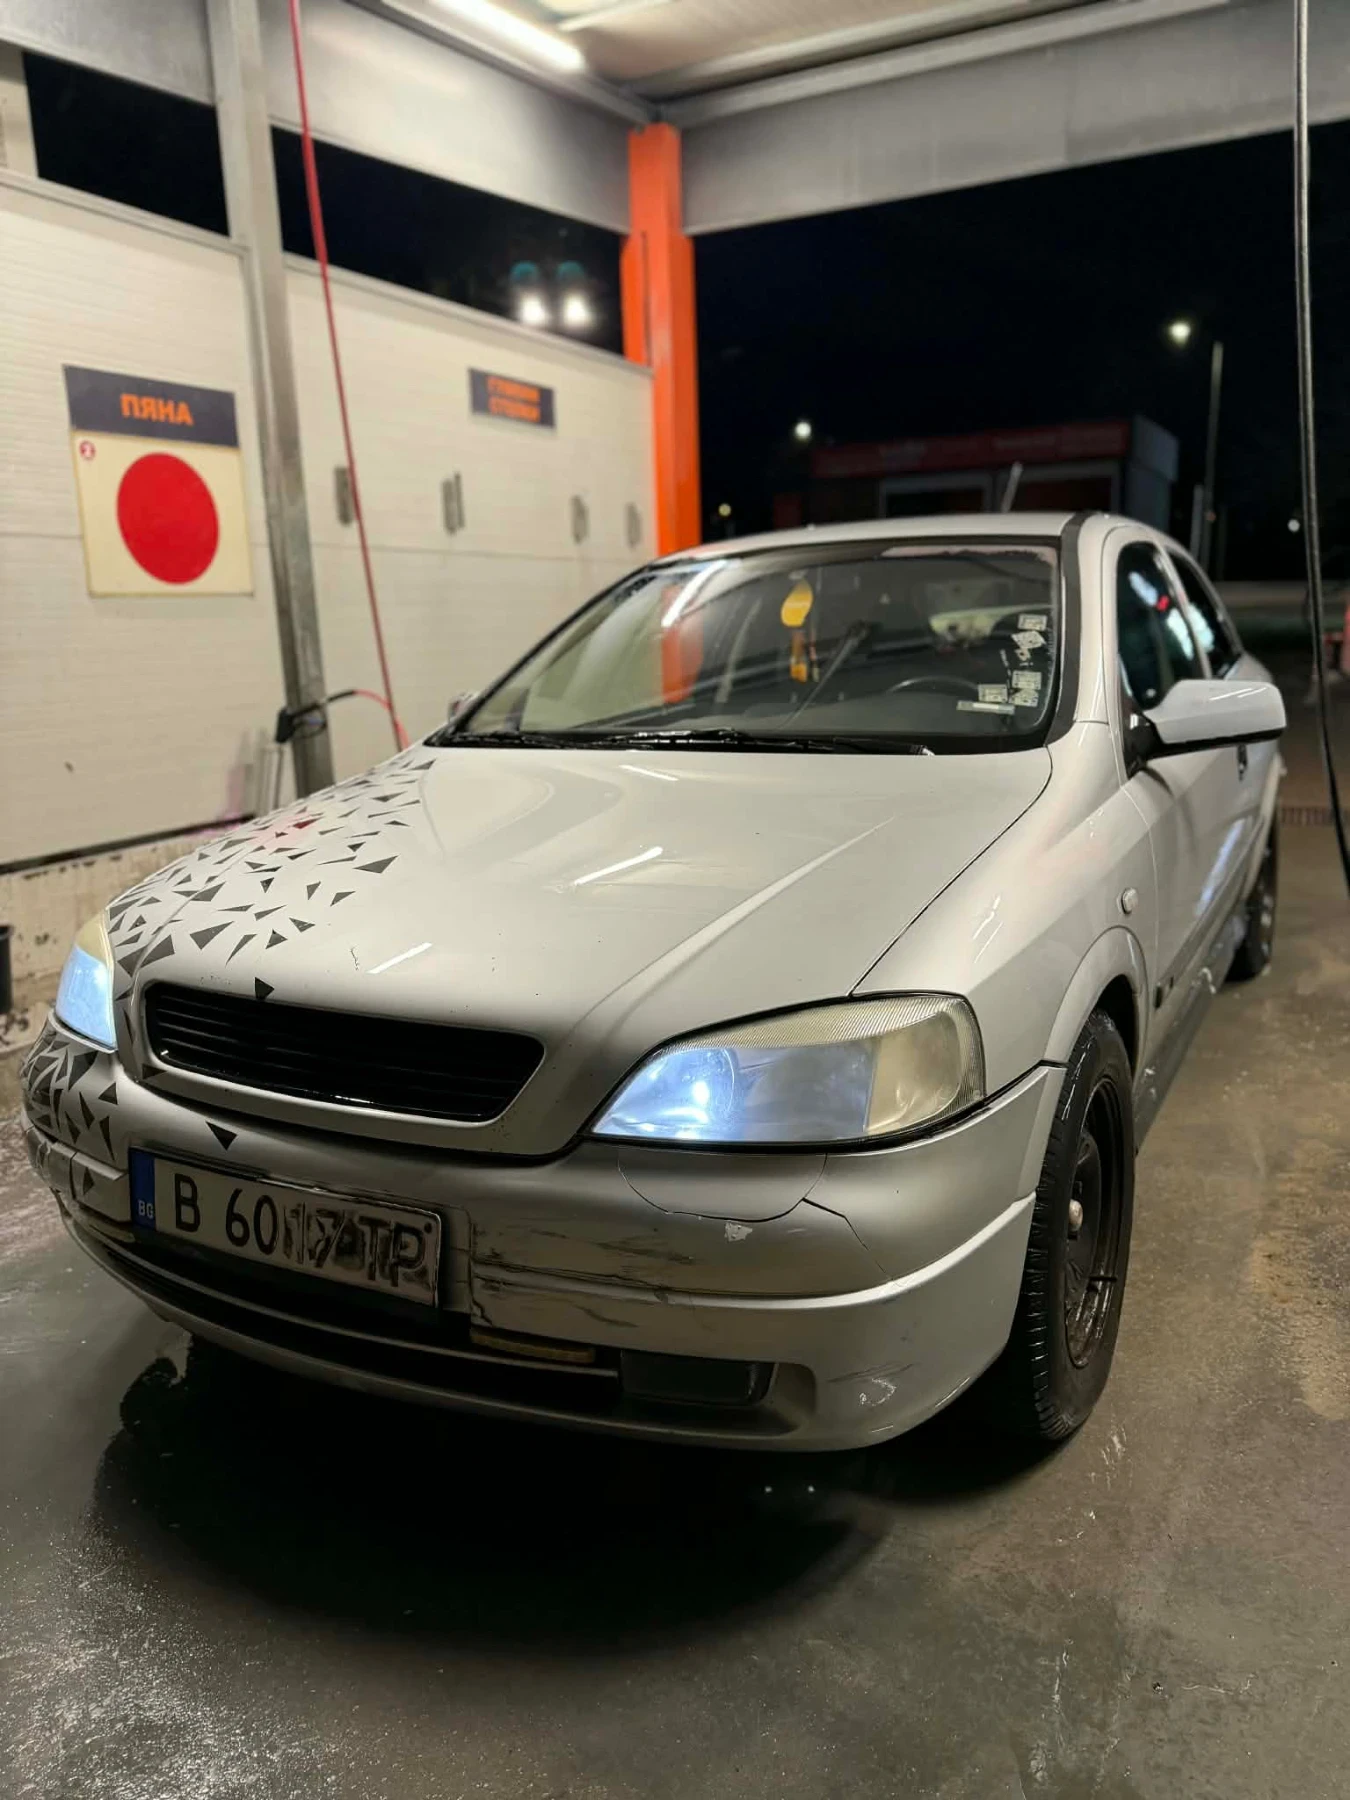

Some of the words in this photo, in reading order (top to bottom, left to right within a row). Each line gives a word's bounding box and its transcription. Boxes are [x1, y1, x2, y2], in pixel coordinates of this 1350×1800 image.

[120, 393, 194, 426] ПЯНА
[138, 1199, 154, 1220] BG
[174, 1173, 200, 1233] B
